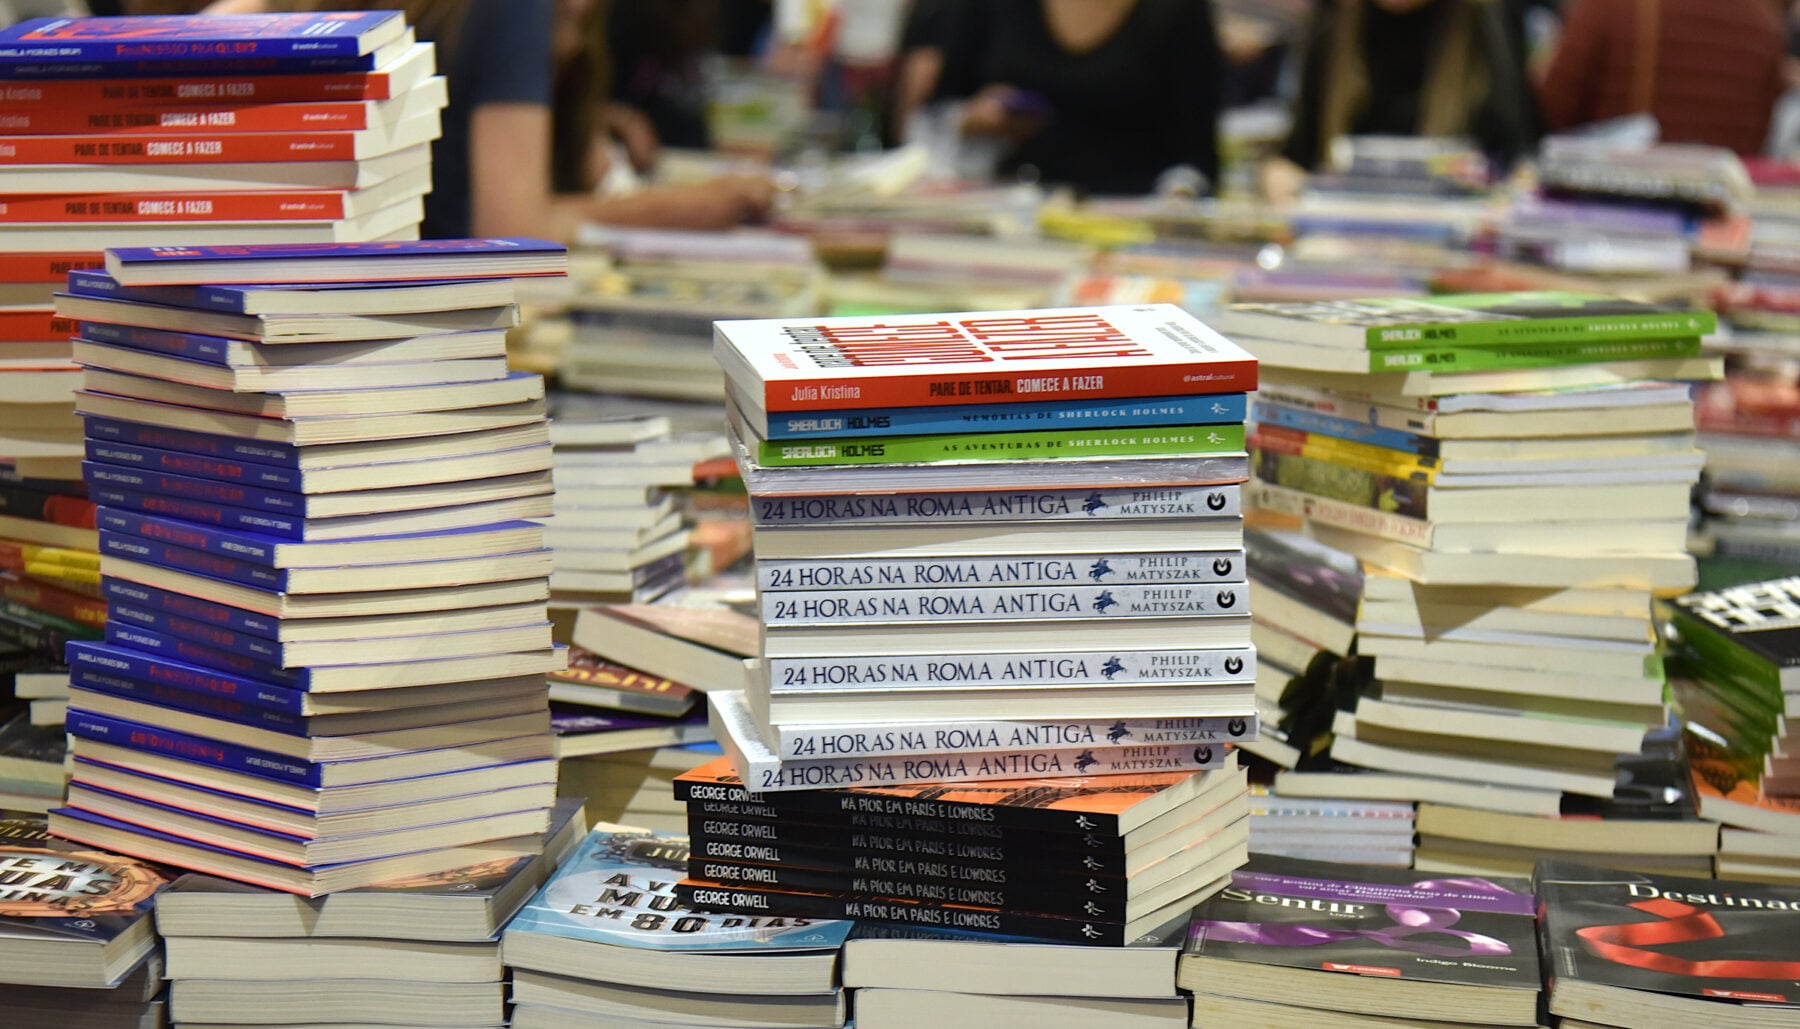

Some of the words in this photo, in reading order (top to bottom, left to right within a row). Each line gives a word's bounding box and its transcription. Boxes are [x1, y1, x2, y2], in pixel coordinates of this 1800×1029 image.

[160, 113, 198, 127] COMECE
[200, 112, 207, 125] A
[208, 112, 236, 125] FAZER
[147, 142, 184, 156] COMECE
[186, 142, 193, 154] A
[195, 141, 222, 154] FAZER
[138, 202, 175, 215] COMECE
[177, 201, 184, 213] A
[186, 201, 213, 214] FAZER
[792, 386, 817, 401] Julia
[821, 385, 861, 400] Kristina
[930, 382, 956, 397] PARE
[958, 381, 972, 395] DE
[1017, 378, 1060, 393] COMECE
[1062, 377, 1070, 391] A
[1072, 375, 1104, 391] FAZER
[1037, 412, 1052, 420] DE
[1059, 410, 1126, 419] SHERLOCK
[1132, 407, 1184, 416] HOLMES
[787, 418, 842, 432] SHERLOCK
[847, 416, 890, 429] HOLMES
[965, 441, 1040, 451] AVENTURAS
[1047, 440, 1062, 448] DE
[1068, 437, 1137, 447] SHERLOCK
[1143, 435, 1195, 444] HOLMES
[782, 446, 836, 459] SHERLOCK
[842, 445, 885, 457] HOLMES
[1133, 492, 1182, 502] PHILIP
[762, 501, 785, 520] 24
[791, 499, 866, 519] HORAS
[871, 499, 898, 517] NA
[907, 496, 972, 517] ROMA
[981, 494, 1070, 515] ANTIGA
[1120, 503, 1195, 514] MATYSZAK
[1139, 557, 1188, 568] PHILIP
[771, 569, 793, 587] 24
[800, 566, 873, 586] HORAS
[879, 565, 906, 584] NA
[914, 563, 980, 583] ROMA
[989, 561, 1077, 582] ANTIGA
[1127, 570, 1201, 580] MATYSZAK
[1143, 589, 1192, 600] PHILIP
[775, 601, 798, 619] 24
[803, 598, 877, 618] HORAS
[883, 597, 910, 616] NA
[919, 596, 983, 615] ROMA
[993, 593, 1080, 613] ANTIGA
[1130, 601, 1204, 612] MATYSZAK
[1151, 655, 1200, 666] PHILIP
[784, 667, 807, 686] 24
[813, 664, 886, 684] HORAS
[891, 663, 919, 682] NA
[927, 661, 993, 681] ROMA
[1002, 659, 1089, 680] ANTIGA
[1138, 668, 1212, 679] MATYSZAK
[1155, 719, 1205, 729] PHILIP
[793, 738, 816, 756] 24
[821, 733, 895, 753] HORAS
[900, 732, 927, 751] NA
[935, 729, 1000, 749] ROMA
[1009, 724, 1095, 746] ANTIGA
[1143, 731, 1216, 743] MATYSZAK
[1123, 747, 1170, 758] PHILIP
[762, 769, 785, 788] 24
[791, 764, 864, 785] HORAS
[868, 762, 896, 781] NA
[903, 759, 969, 779] ROMA
[977, 754, 1062, 775] ANTIGA
[1110, 758, 1182, 770] MATYSZAK
[690, 786, 727, 802] GEORGE
[728, 788, 765, 803] ORWELL
[704, 803, 739, 815] GEORGE
[742, 806, 777, 818] ORWELL
[859, 798, 883, 813] PIOR
[886, 800, 903, 814] EM
[905, 802, 936, 817] PARIS
[939, 805, 945, 817] E
[703, 821, 739, 836] GEORGE
[742, 824, 777, 840] ORWELL
[706, 842, 742, 858] GEORGE
[744, 845, 780, 861] ORWELL
[704, 864, 740, 880] GEORGE
[742, 867, 778, 883] ORWELL
[872, 858, 896, 873] PIOR
[900, 860, 916, 874] EM
[918, 862, 948, 878] PARIS
[951, 865, 957, 878] E
[604, 873, 632, 888] A
[870, 880, 894, 894] PIOR
[897, 882, 913, 895] EM
[916, 884, 945, 899] PARIS
[949, 887, 954, 900] E
[693, 890, 730, 906] GEORGE
[731, 892, 769, 909] ORWELL
[1221, 888, 1365, 914] Sentir
[569, 903, 626, 920] EM
[630, 913, 709, 933] 80
[863, 904, 887, 919] PIOR
[890, 906, 908, 920] EM
[910, 908, 941, 924] PARIS
[944, 911, 949, 924] E
[1416, 957, 1458, 966] Indigo
